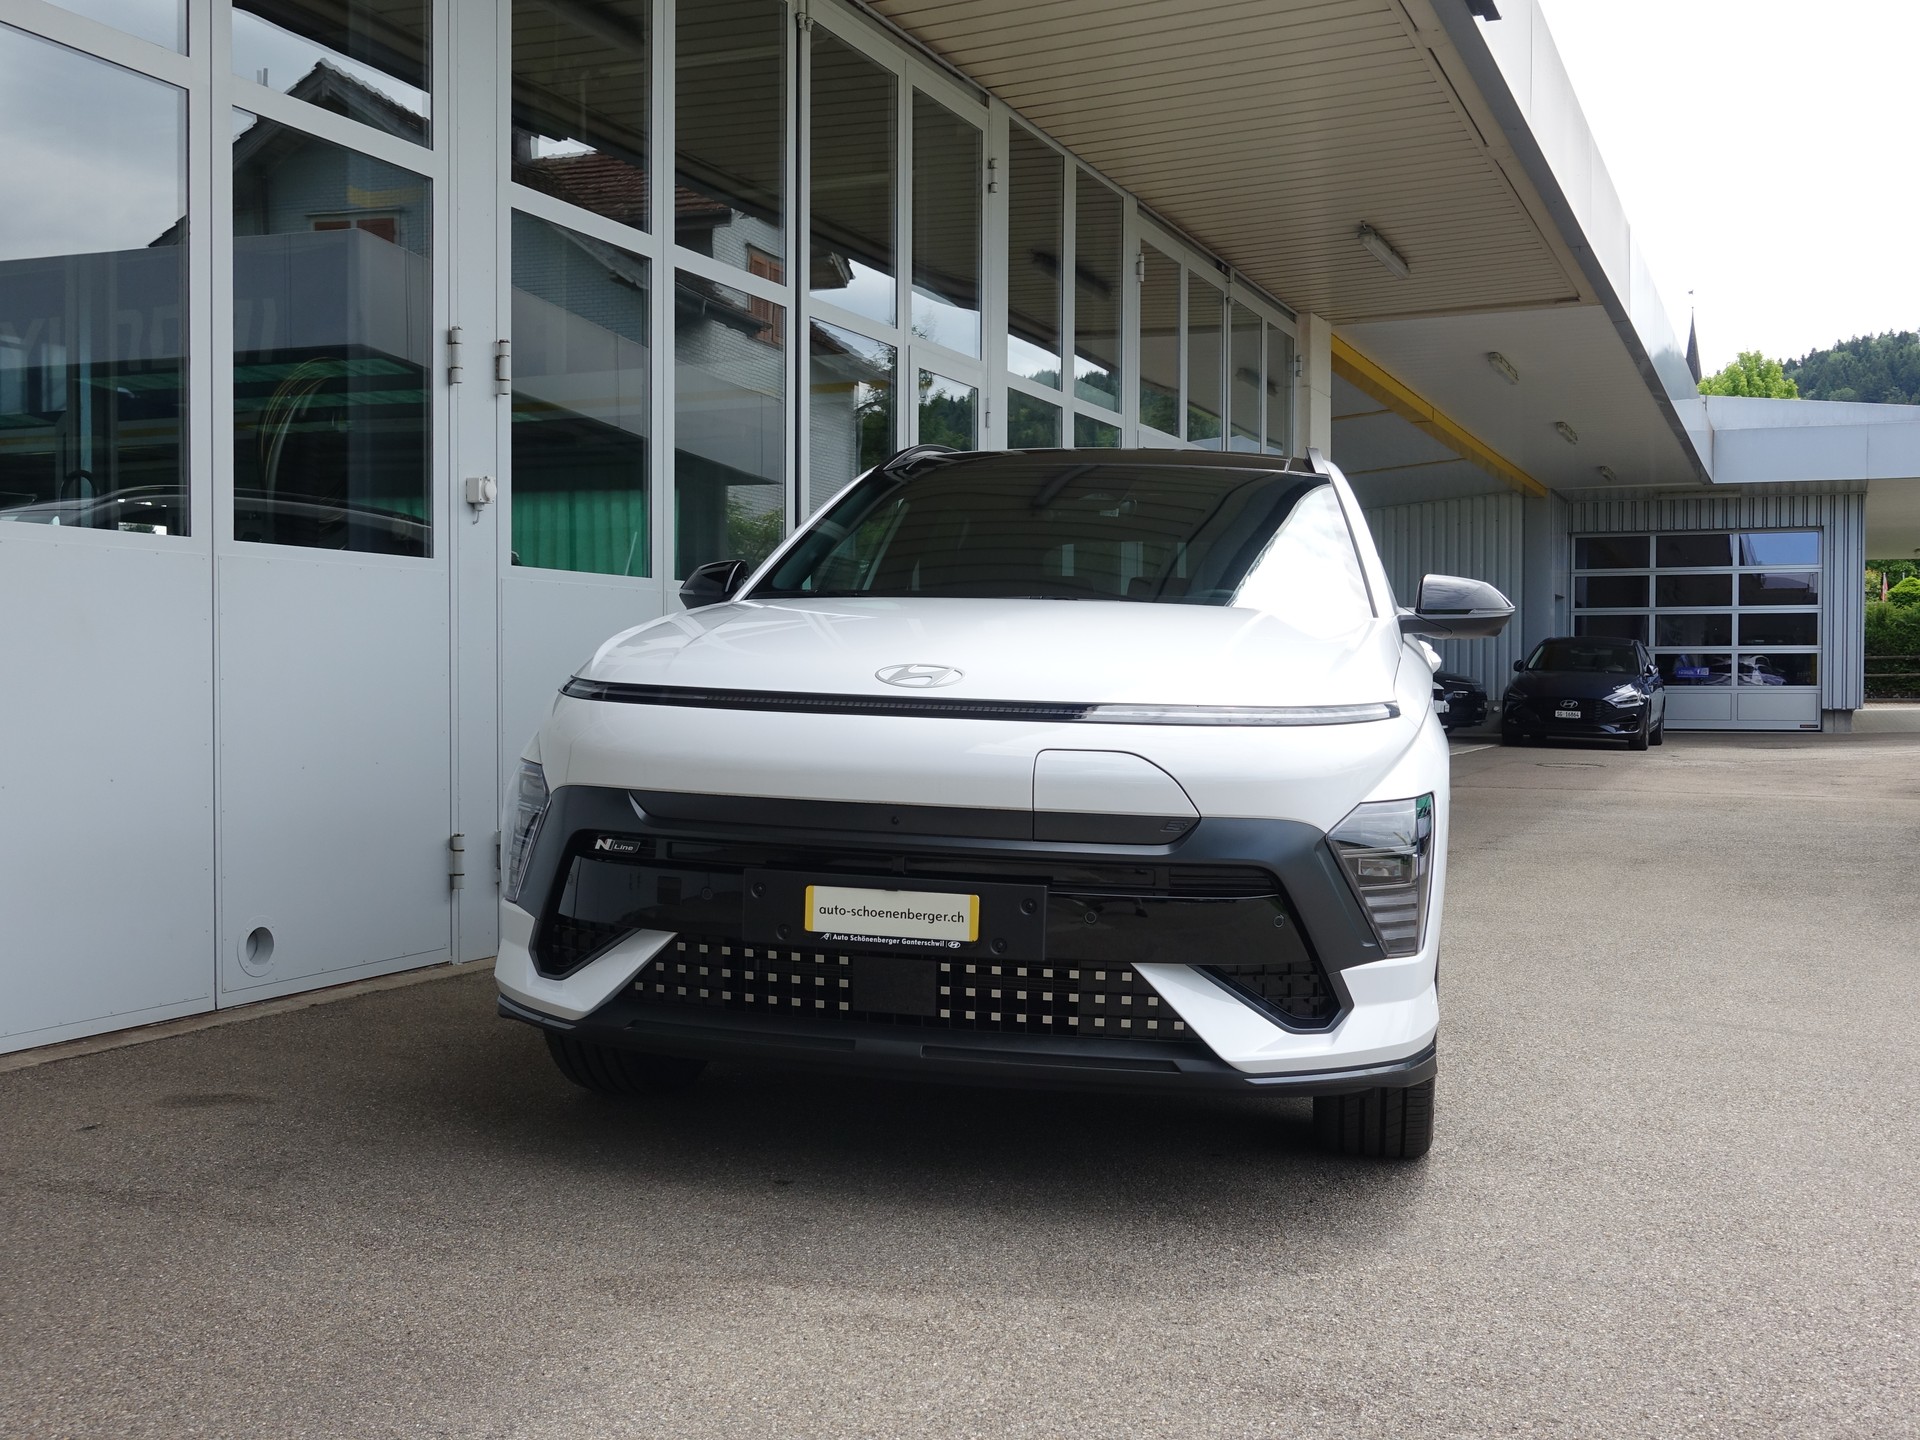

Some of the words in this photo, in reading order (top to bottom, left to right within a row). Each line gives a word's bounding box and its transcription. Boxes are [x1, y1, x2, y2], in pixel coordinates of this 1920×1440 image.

[595, 838, 613, 850] N
[819, 905, 965, 924] auto-schoenenberger.ch
[832, 933, 849, 941] Auto
[850, 934, 900, 945] Schönenberger
[901, 938, 945, 947] Ganterschwil
